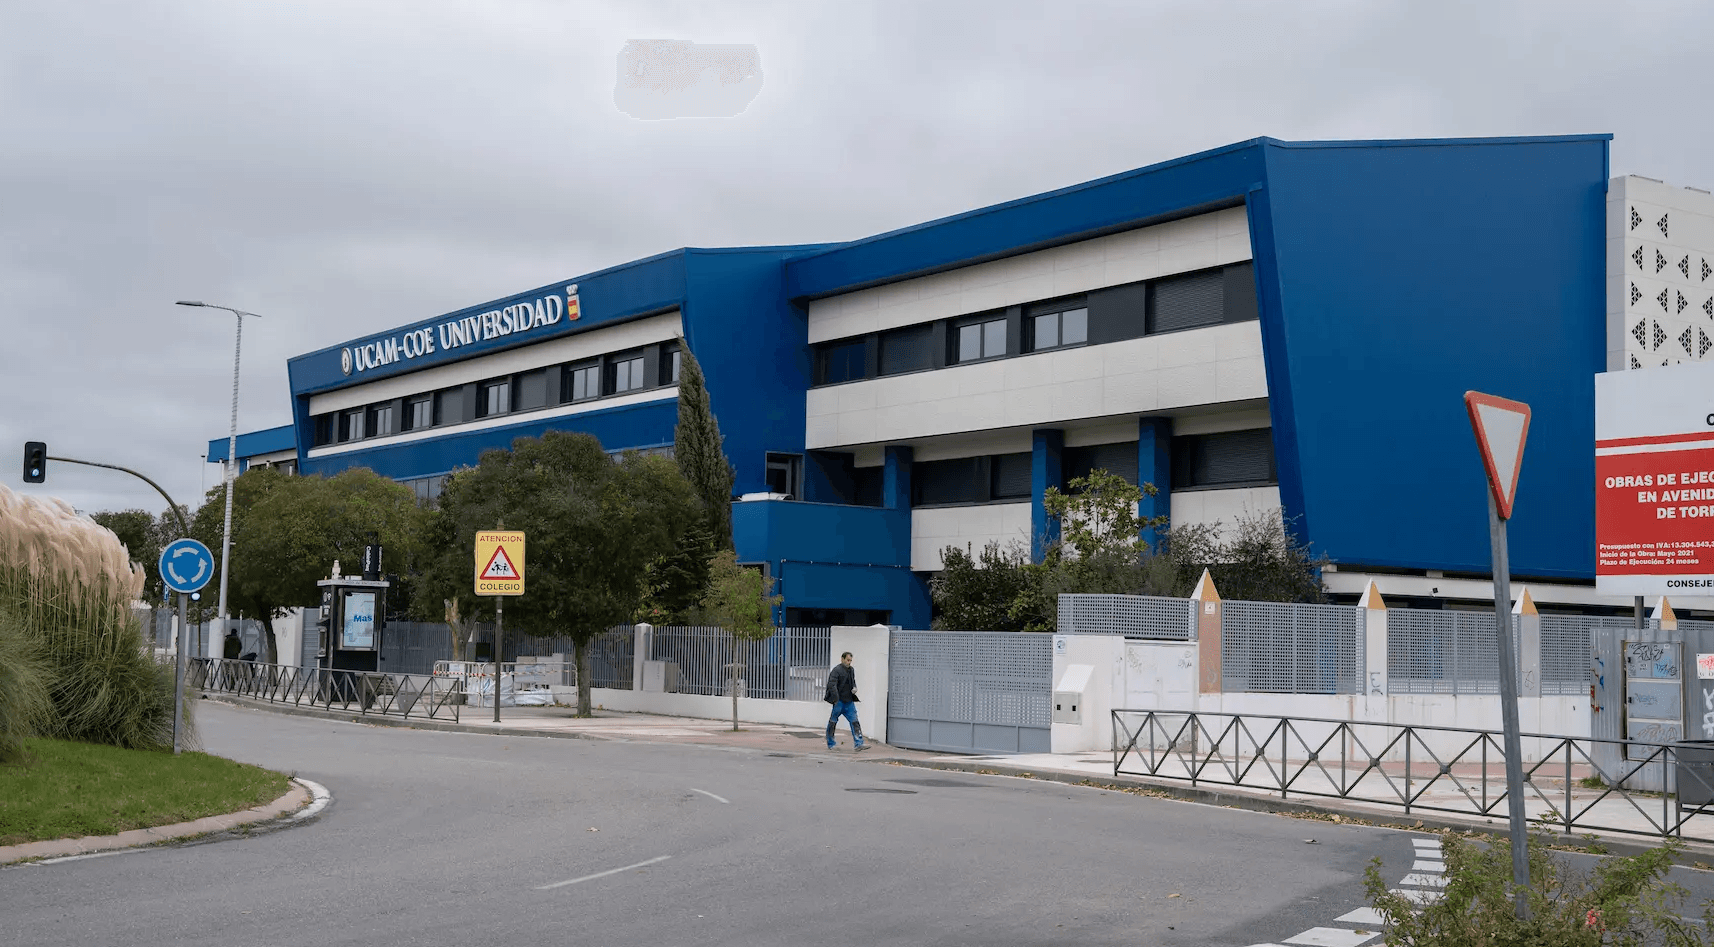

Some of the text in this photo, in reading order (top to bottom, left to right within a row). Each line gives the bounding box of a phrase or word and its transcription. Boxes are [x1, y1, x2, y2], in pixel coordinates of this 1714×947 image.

[354, 294, 563, 372] UCAM-COE UNIVERSIDAD
[1605, 475, 1653, 488] OBRAS
[1657, 473, 1677, 486] DE
[1638, 488, 1714, 503] EN AVENID
[1656, 507, 1677, 519] DE
[1629, 558, 1664, 566] Ejecución:
[480, 583, 520, 591] COLEGIO
[1667, 579, 1714, 588] CONSEJE
